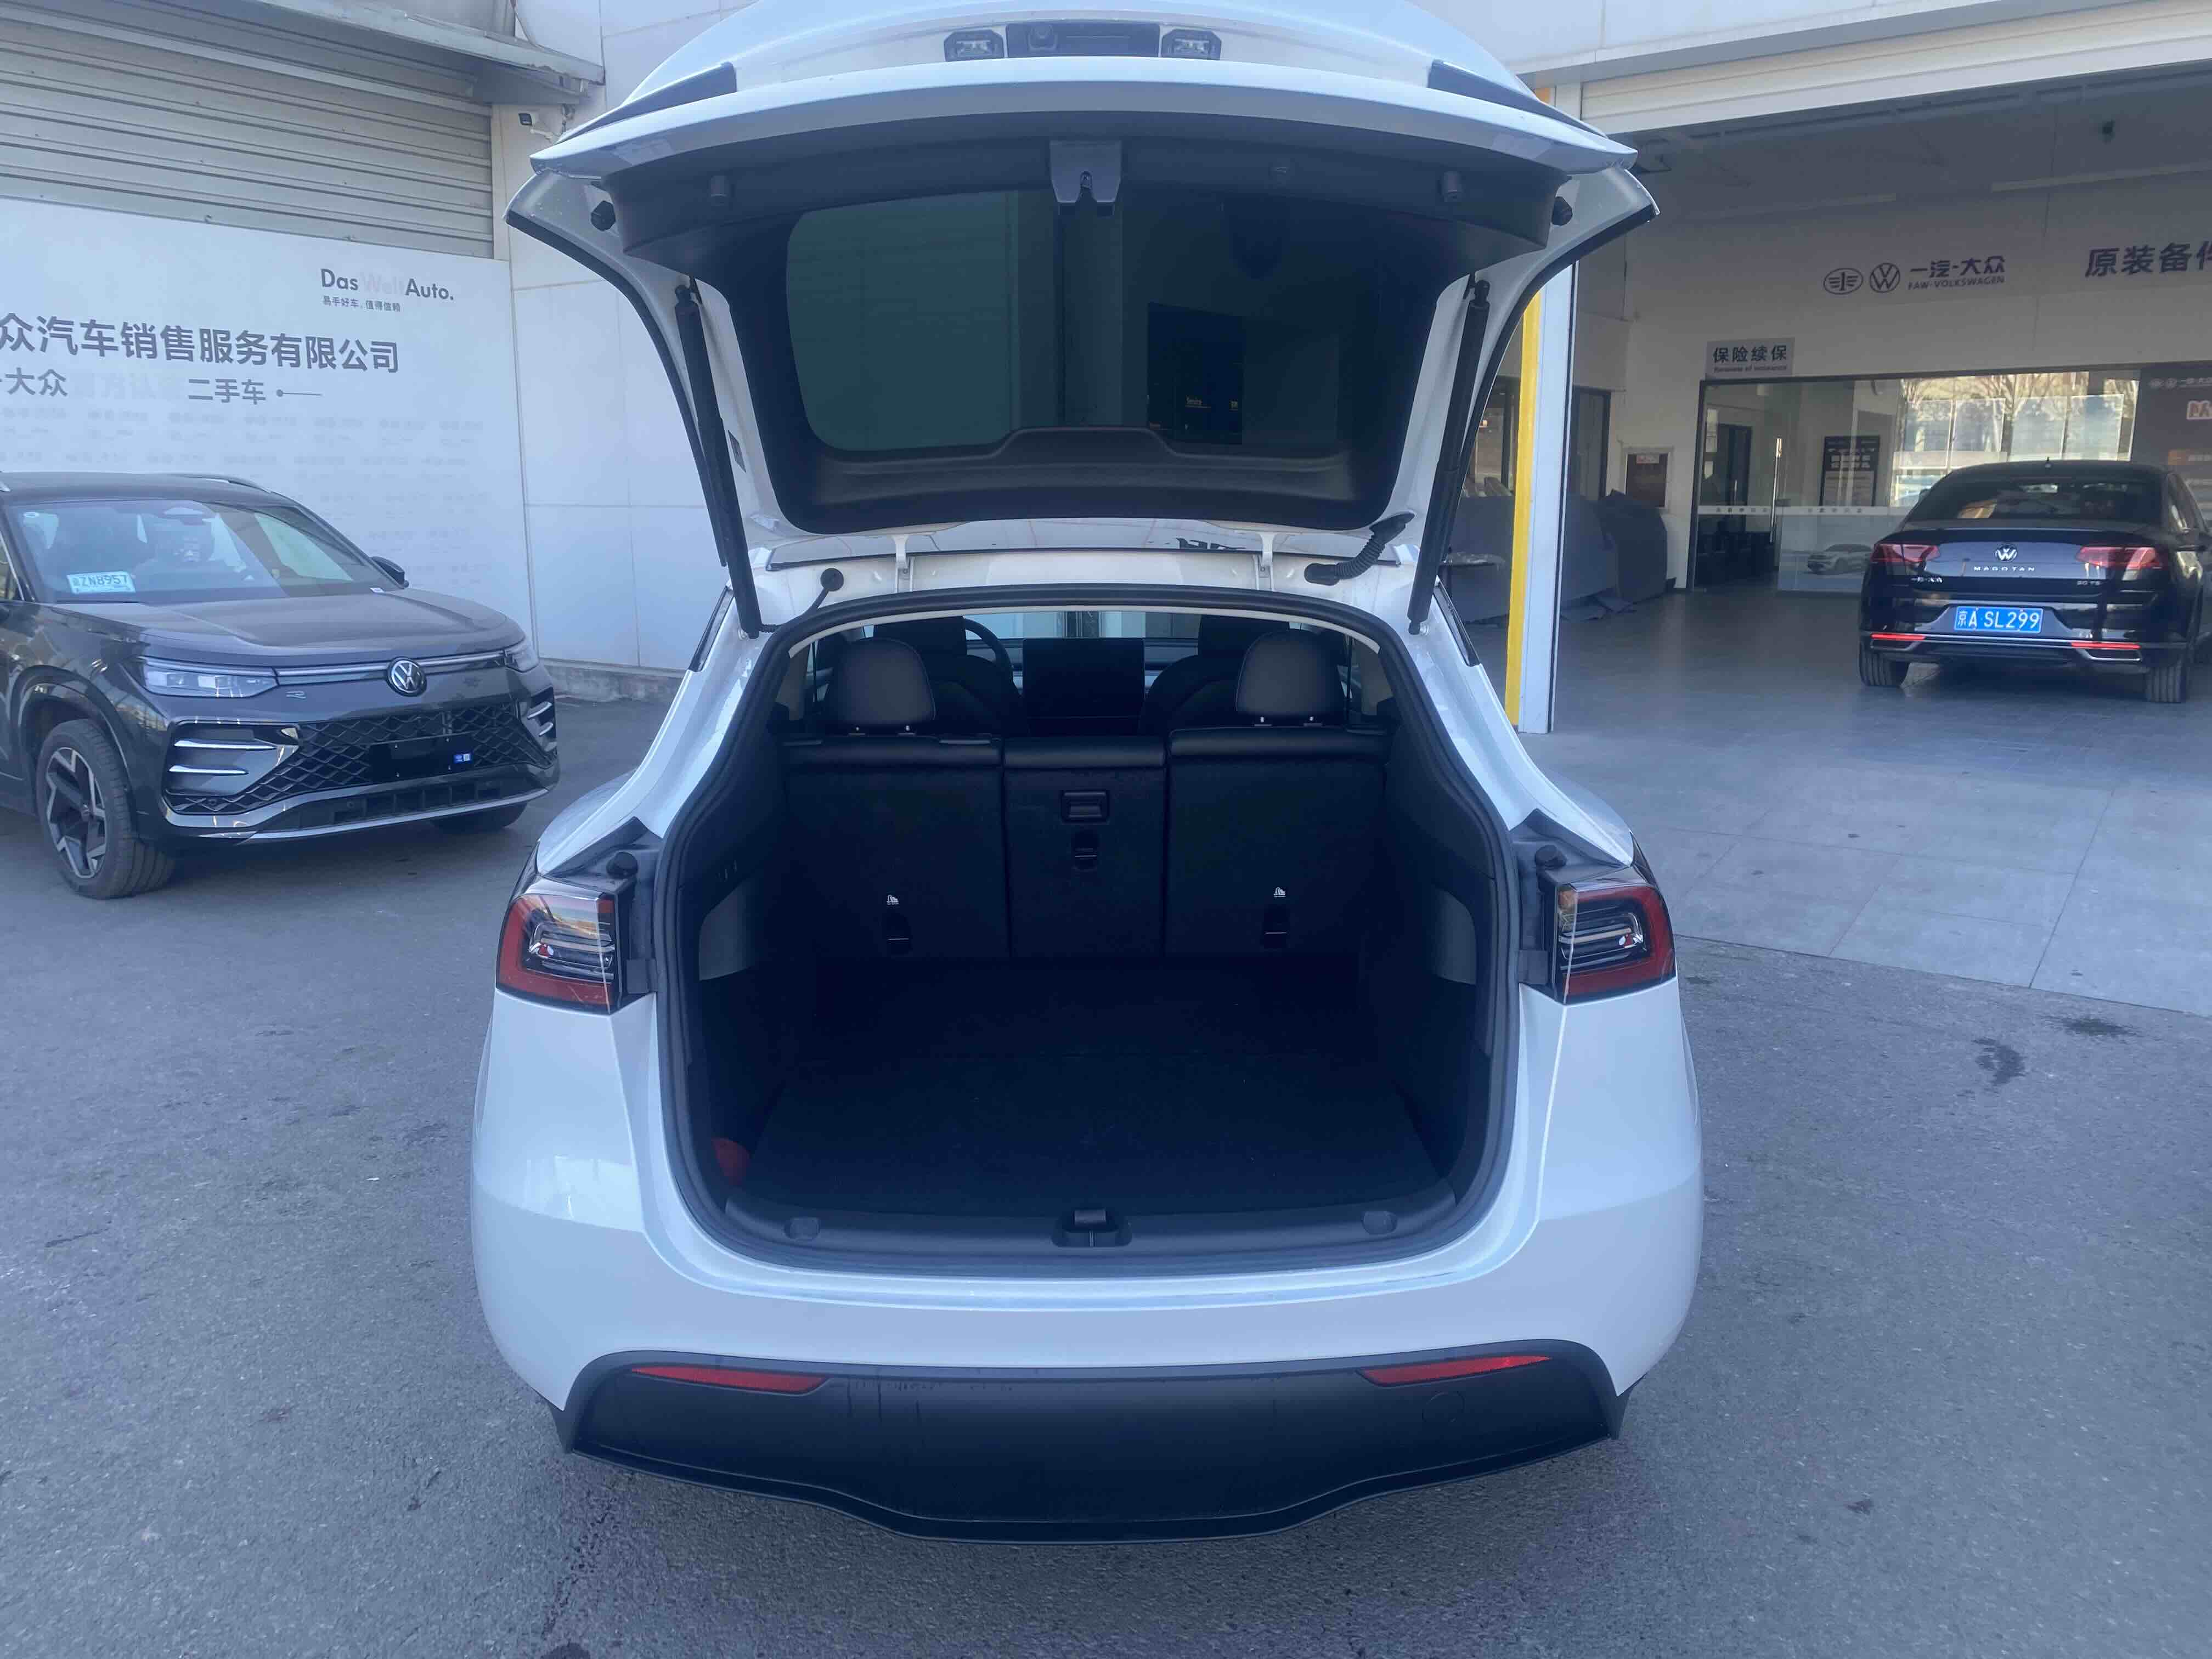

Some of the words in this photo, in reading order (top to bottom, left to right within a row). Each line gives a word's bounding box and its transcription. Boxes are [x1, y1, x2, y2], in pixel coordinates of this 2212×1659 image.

[320, 268, 359, 291] Das
[405, 278, 454, 301] Auto.
[0, 312, 399, 373] 众汽车销售服务有限公司
[1713, 345, 1787, 364] 保险续保
[188, 378, 267, 405] 二手车
